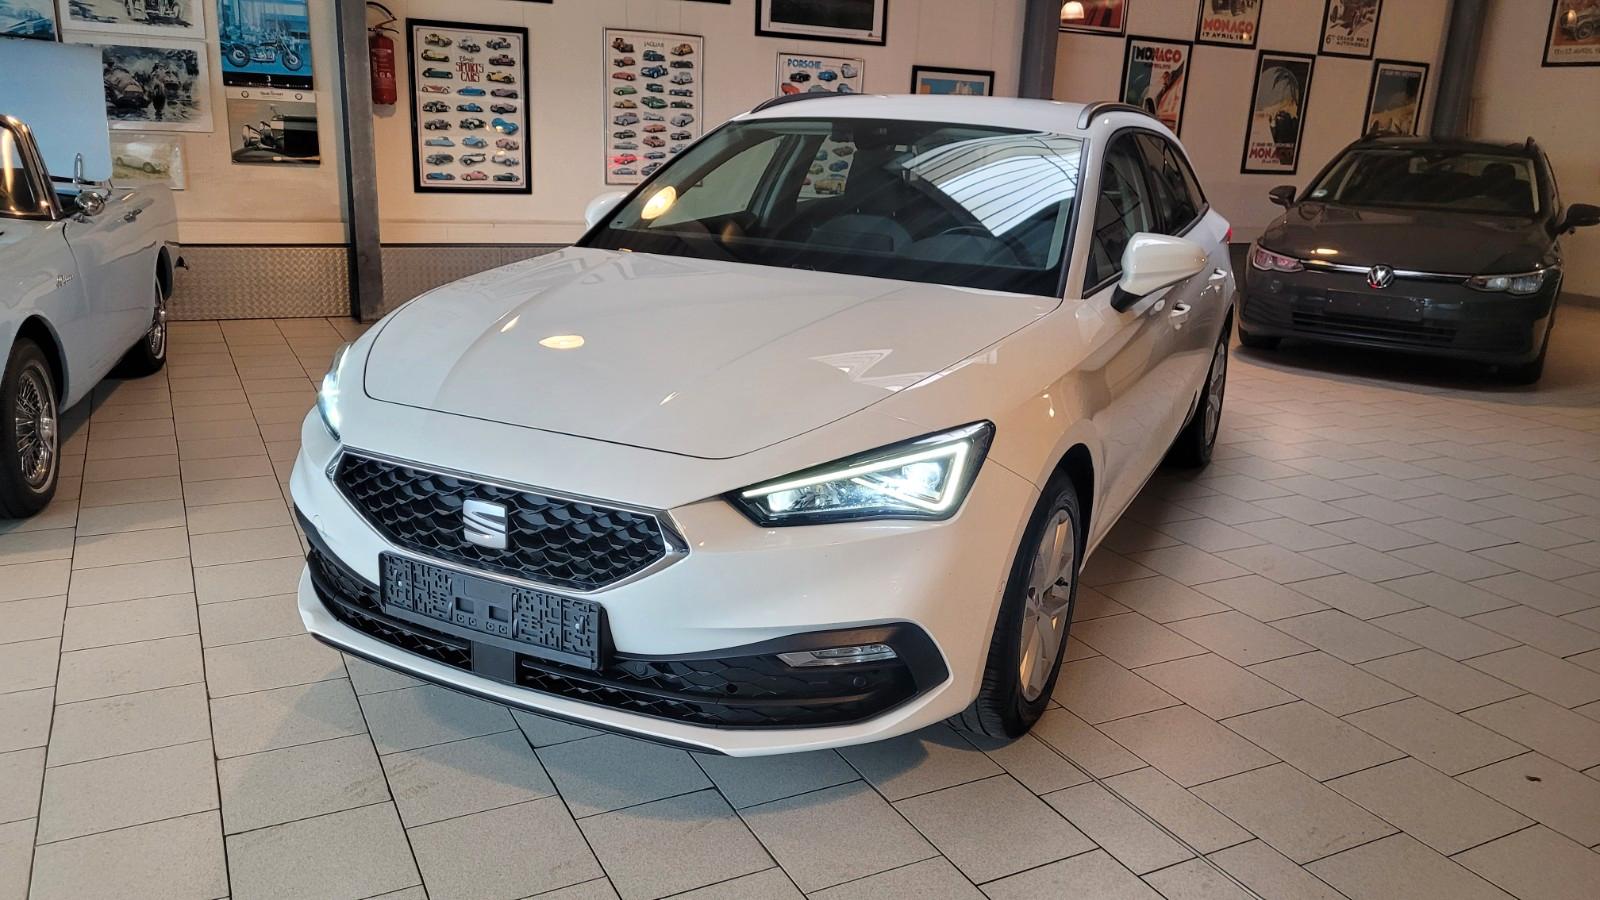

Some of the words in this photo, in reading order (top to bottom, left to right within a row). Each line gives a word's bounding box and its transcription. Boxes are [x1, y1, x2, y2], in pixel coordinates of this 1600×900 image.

[1203, 17, 1253, 34] MONACO
[1135, 46, 1182, 63] MONACO
[455, 61, 485, 73] SPORTS
[787, 58, 822, 69] PORSCHE
[460, 71, 480, 83] CARS
